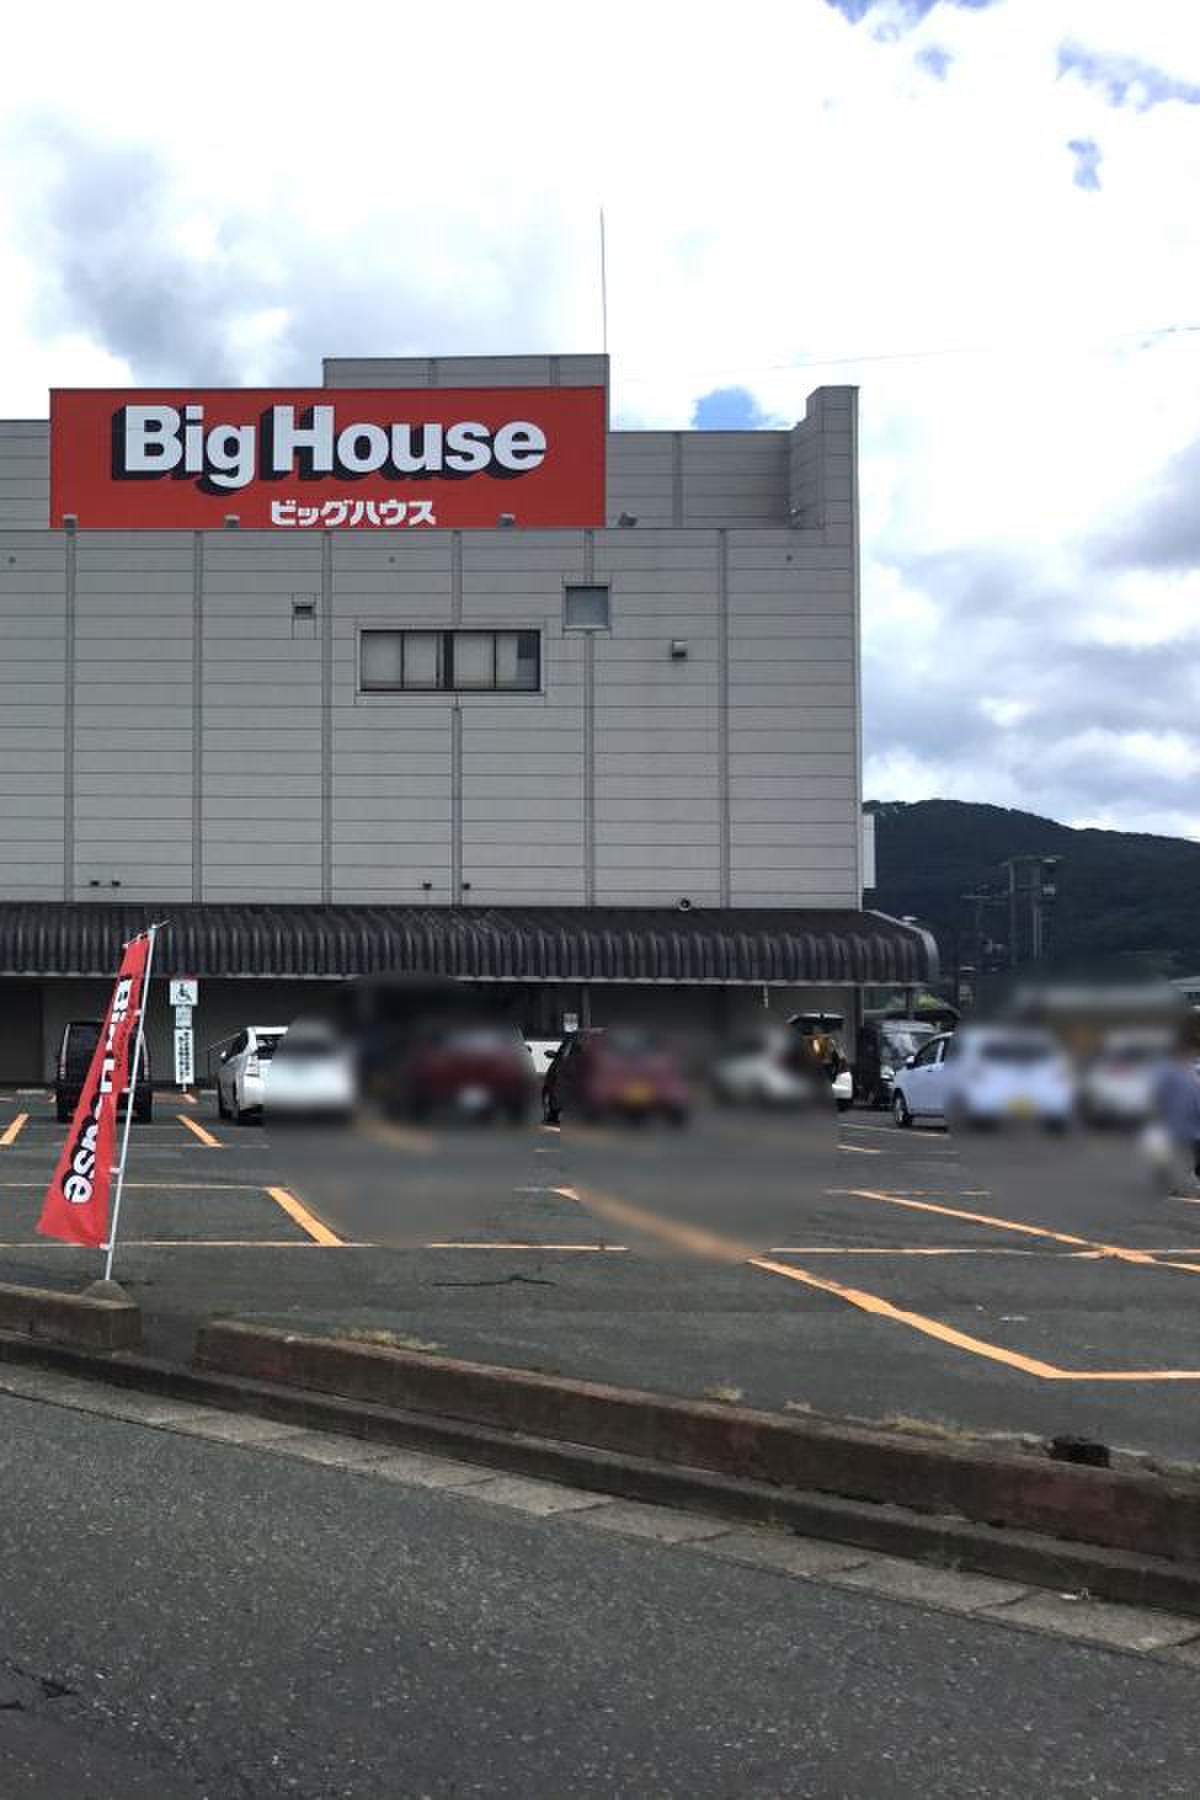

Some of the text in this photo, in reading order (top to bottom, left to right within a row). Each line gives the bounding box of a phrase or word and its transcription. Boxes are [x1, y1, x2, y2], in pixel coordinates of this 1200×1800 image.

[122, 404, 548, 489] Big House
[270, 499, 437, 527] ビッグハウス
[63, 978, 132, 1204] Bi Huse
